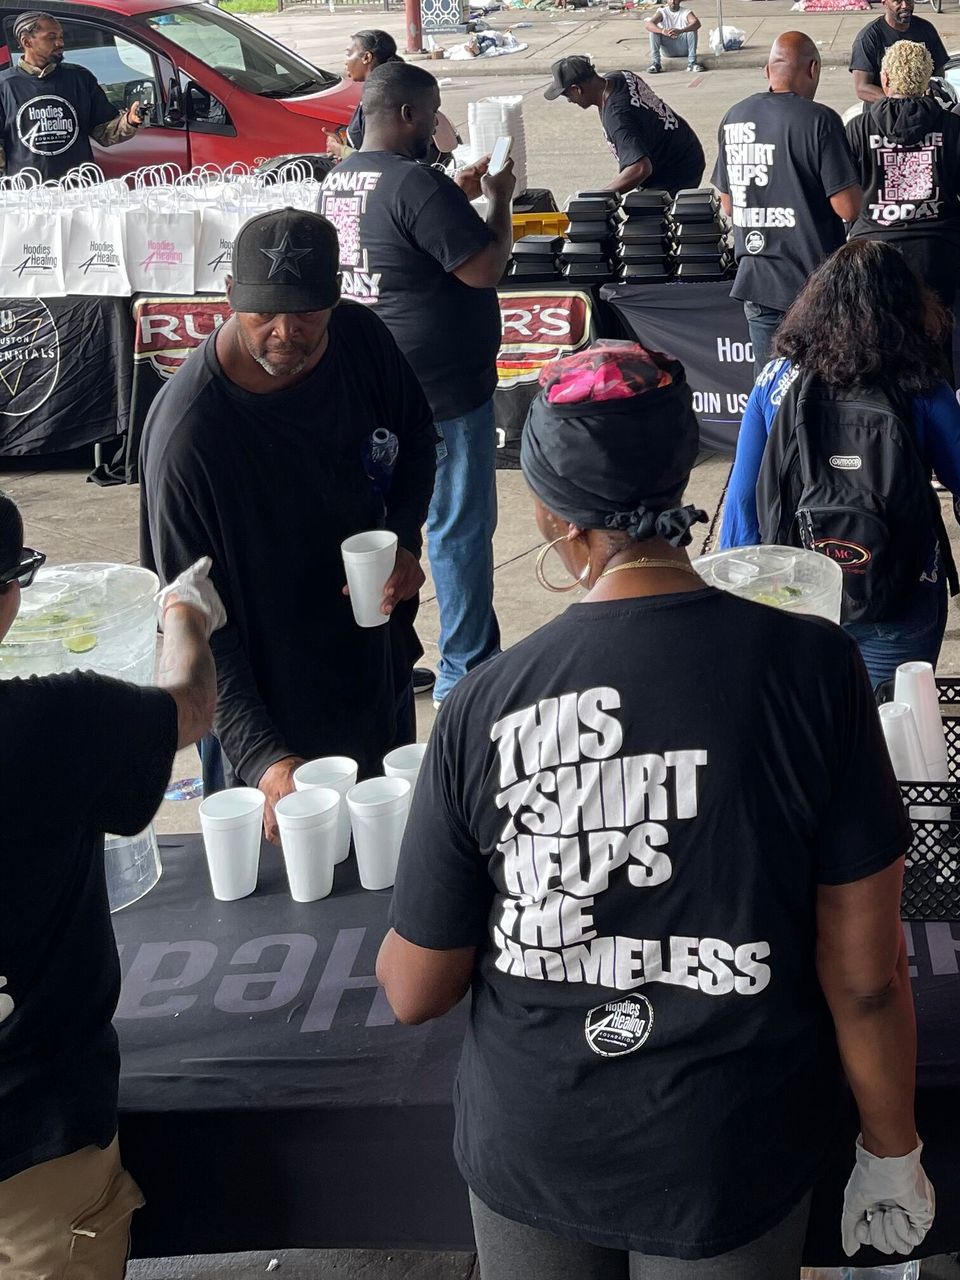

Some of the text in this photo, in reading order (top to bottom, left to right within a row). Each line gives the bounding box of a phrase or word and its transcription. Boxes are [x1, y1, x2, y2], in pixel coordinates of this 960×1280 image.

[28, 105, 64, 121] Hoodies
[40, 117, 73, 132] Healing
[723, 121, 756, 144] THIS
[321, 171, 382, 191] DONATE
[868, 201, 945, 221] TODAY
[23, 244, 51, 255] Hoodies
[340, 270, 381, 297] DAY
[0, 336, 29, 345] USTON
[0, 347, 55, 362] ENNIALS
[692, 391, 721, 413] OIN
[490, 686, 623, 789] THIS
[495, 749, 708, 842] TSHIRT
[496, 821, 673, 898] HELPS
[500, 891, 598, 948] THE
[494, 924, 772, 995] HOMELESS
[605, 1000, 641, 1018] Hoodies
[611, 1010, 646, 1037] Healing
